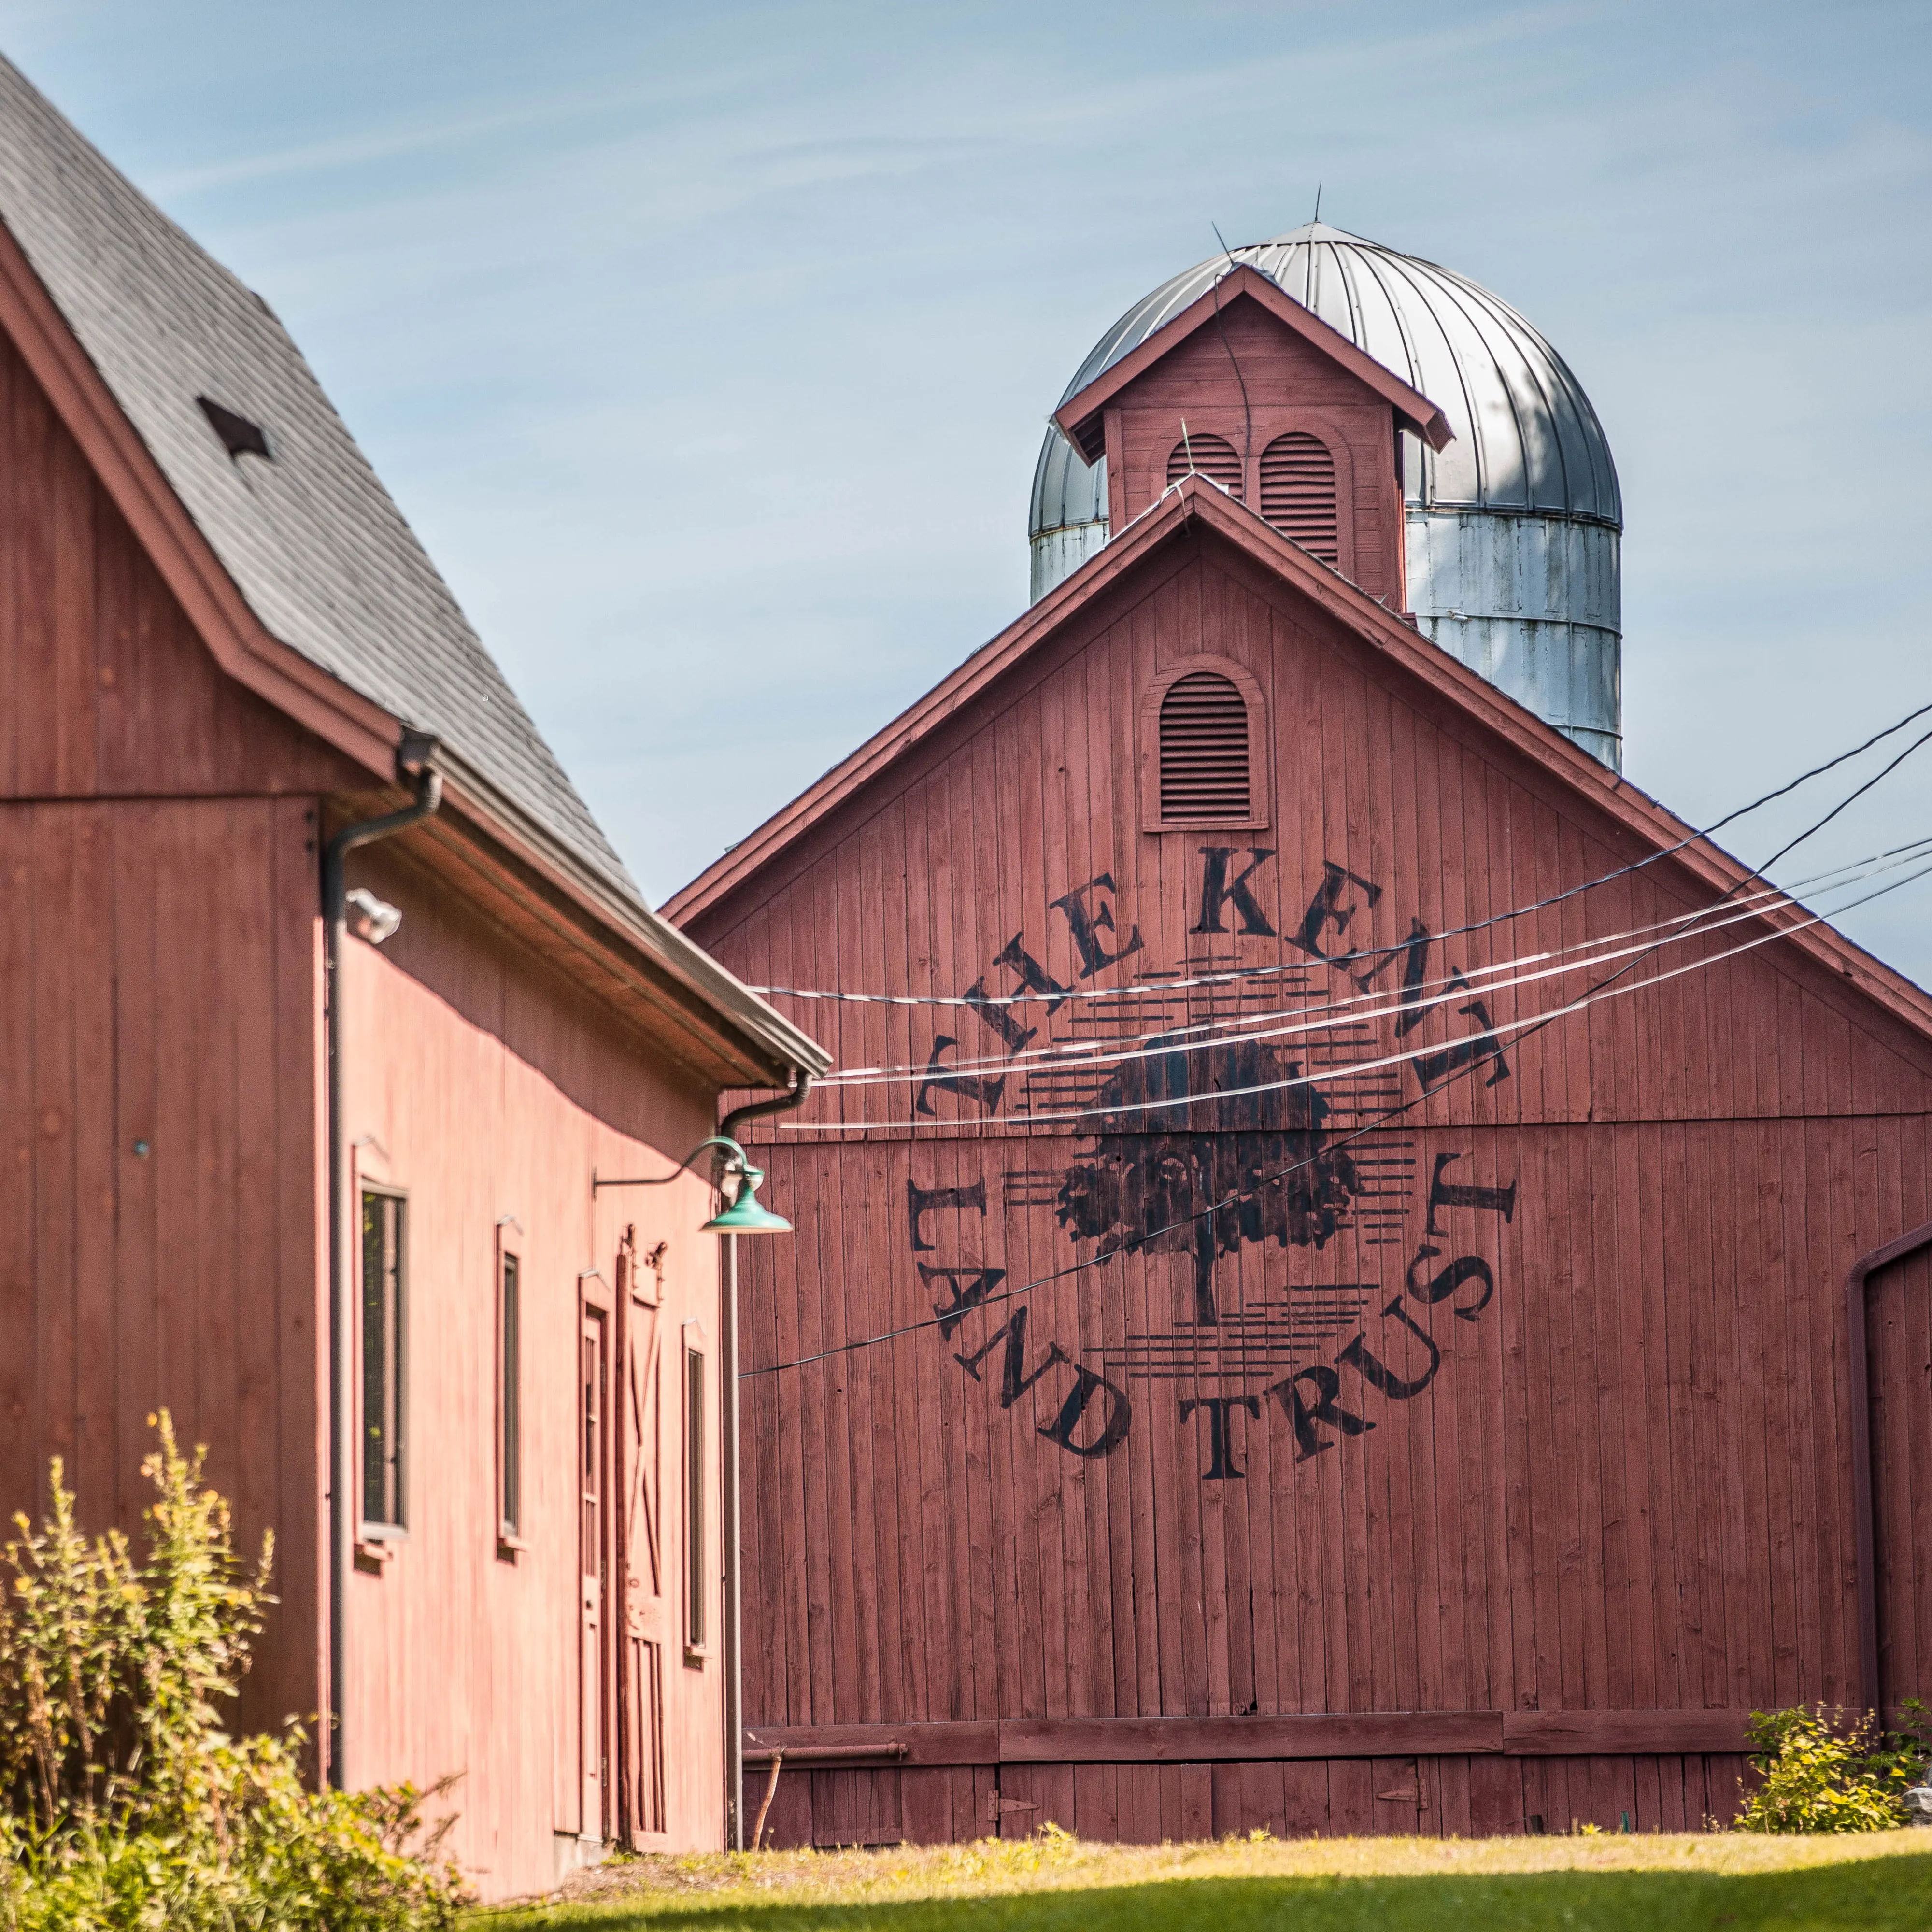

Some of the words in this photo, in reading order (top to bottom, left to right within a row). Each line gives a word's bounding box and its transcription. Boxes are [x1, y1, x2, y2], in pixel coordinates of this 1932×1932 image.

[917, 872, 1145, 1116] THE
[1189, 847, 1511, 1095] KENT
[908, 1177, 1131, 1459] LAND
[1179, 1153, 1517, 1481] TRUST
